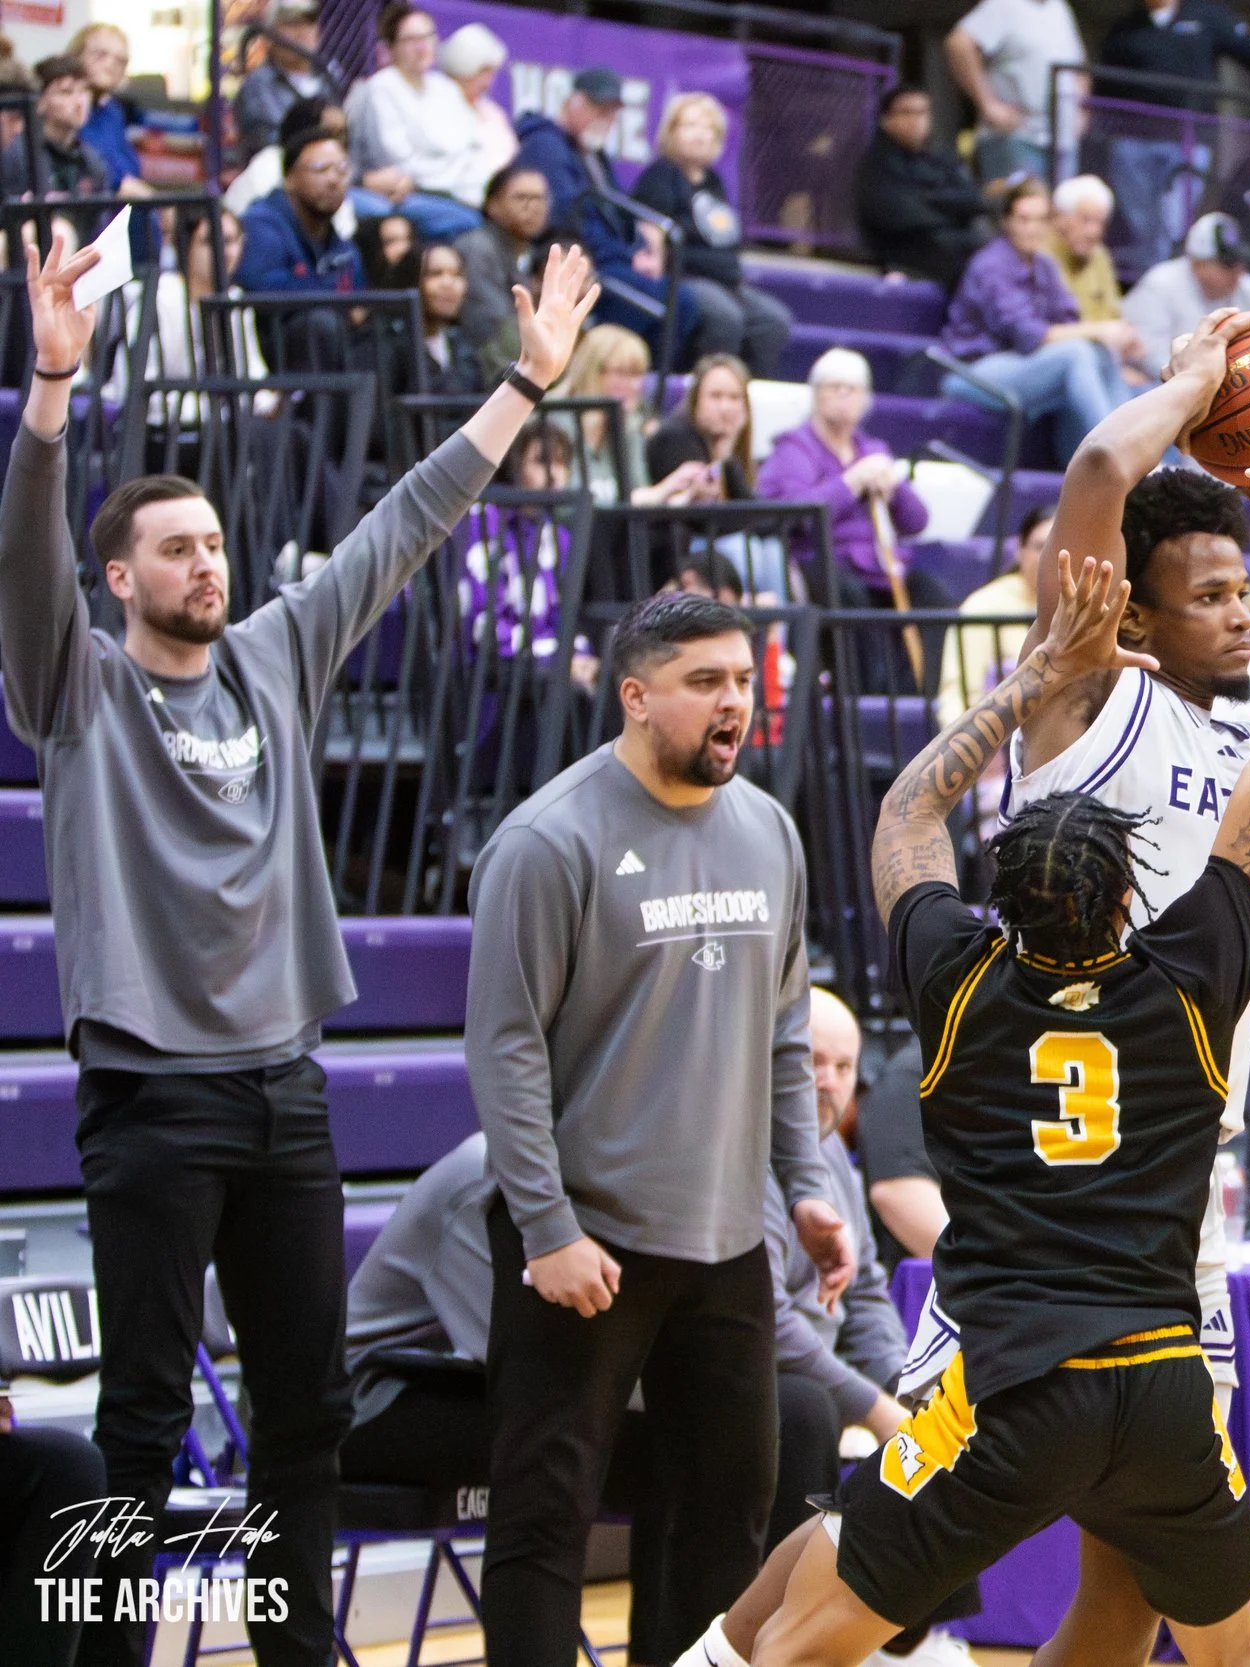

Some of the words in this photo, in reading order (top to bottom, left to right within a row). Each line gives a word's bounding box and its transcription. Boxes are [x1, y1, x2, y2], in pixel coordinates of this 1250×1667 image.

[511, 64, 652, 164] HOE
[1168, 764, 1232, 823] EA
[640, 889, 769, 932] BRAVESHOOPS
[1028, 1031, 1121, 1166] 3
